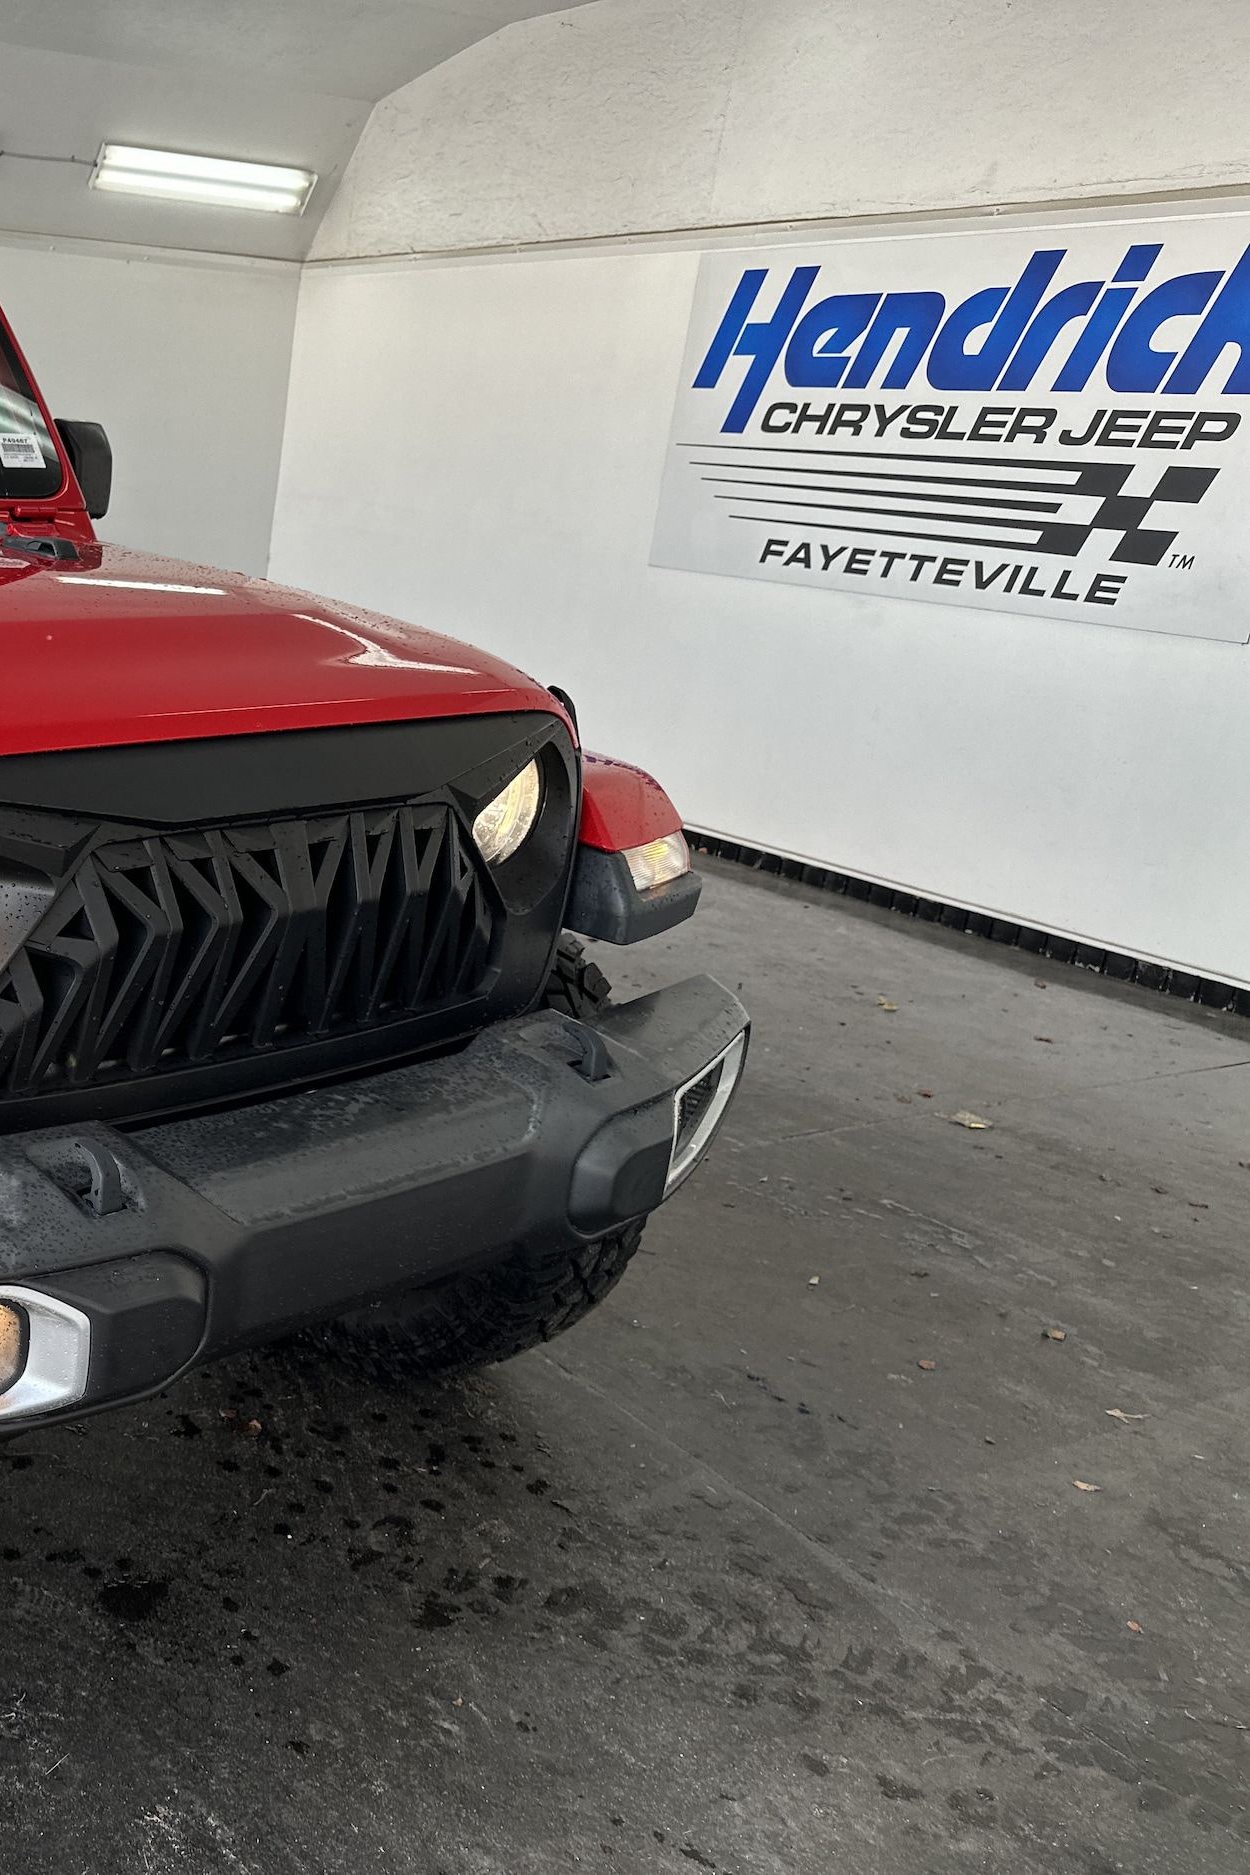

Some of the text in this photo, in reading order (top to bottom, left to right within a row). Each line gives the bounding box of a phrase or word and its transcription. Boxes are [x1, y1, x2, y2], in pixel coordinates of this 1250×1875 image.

[760, 402, 1242, 450] CHRYSLER JEEP
[759, 539, 1127, 605] FAYETTEVILLE
